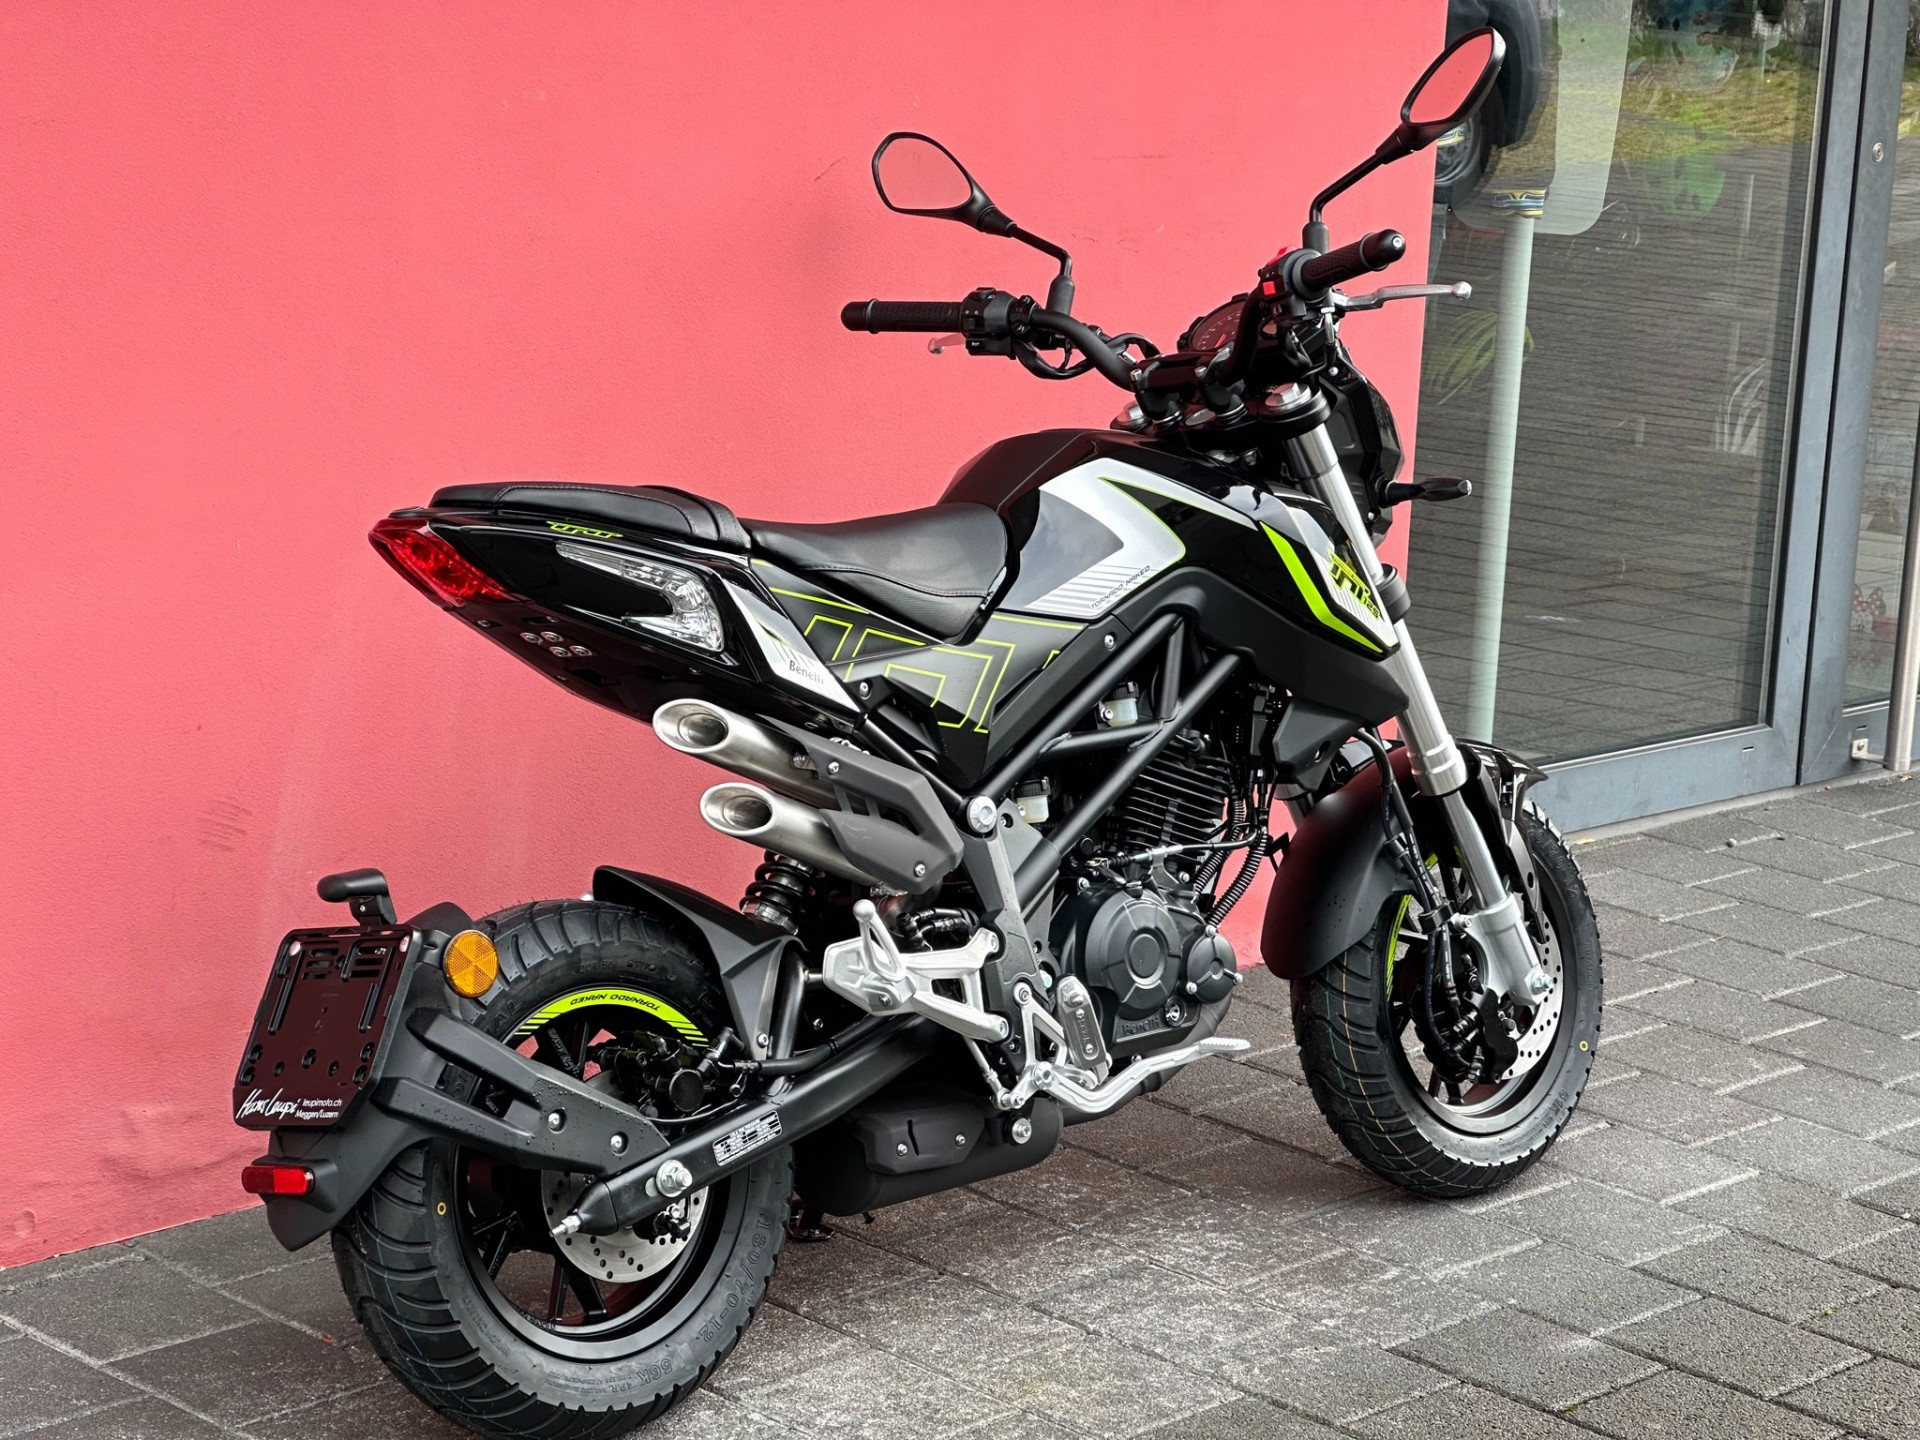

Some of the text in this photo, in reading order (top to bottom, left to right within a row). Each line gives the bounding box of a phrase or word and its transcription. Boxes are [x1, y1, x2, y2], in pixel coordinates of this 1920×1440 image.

[1091, 565, 1150, 609] TORNADO NAKED
[789, 659, 824, 685] Benelli
[570, 993, 661, 1011] TORNADO NAKED
[235, 1088, 301, 1120] Hans Leupi
[294, 1108, 339, 1120] Meggen/Luzern
[302, 1098, 342, 1108] leupimoto.ch
[698, 1217, 771, 1343] 130/70-12
